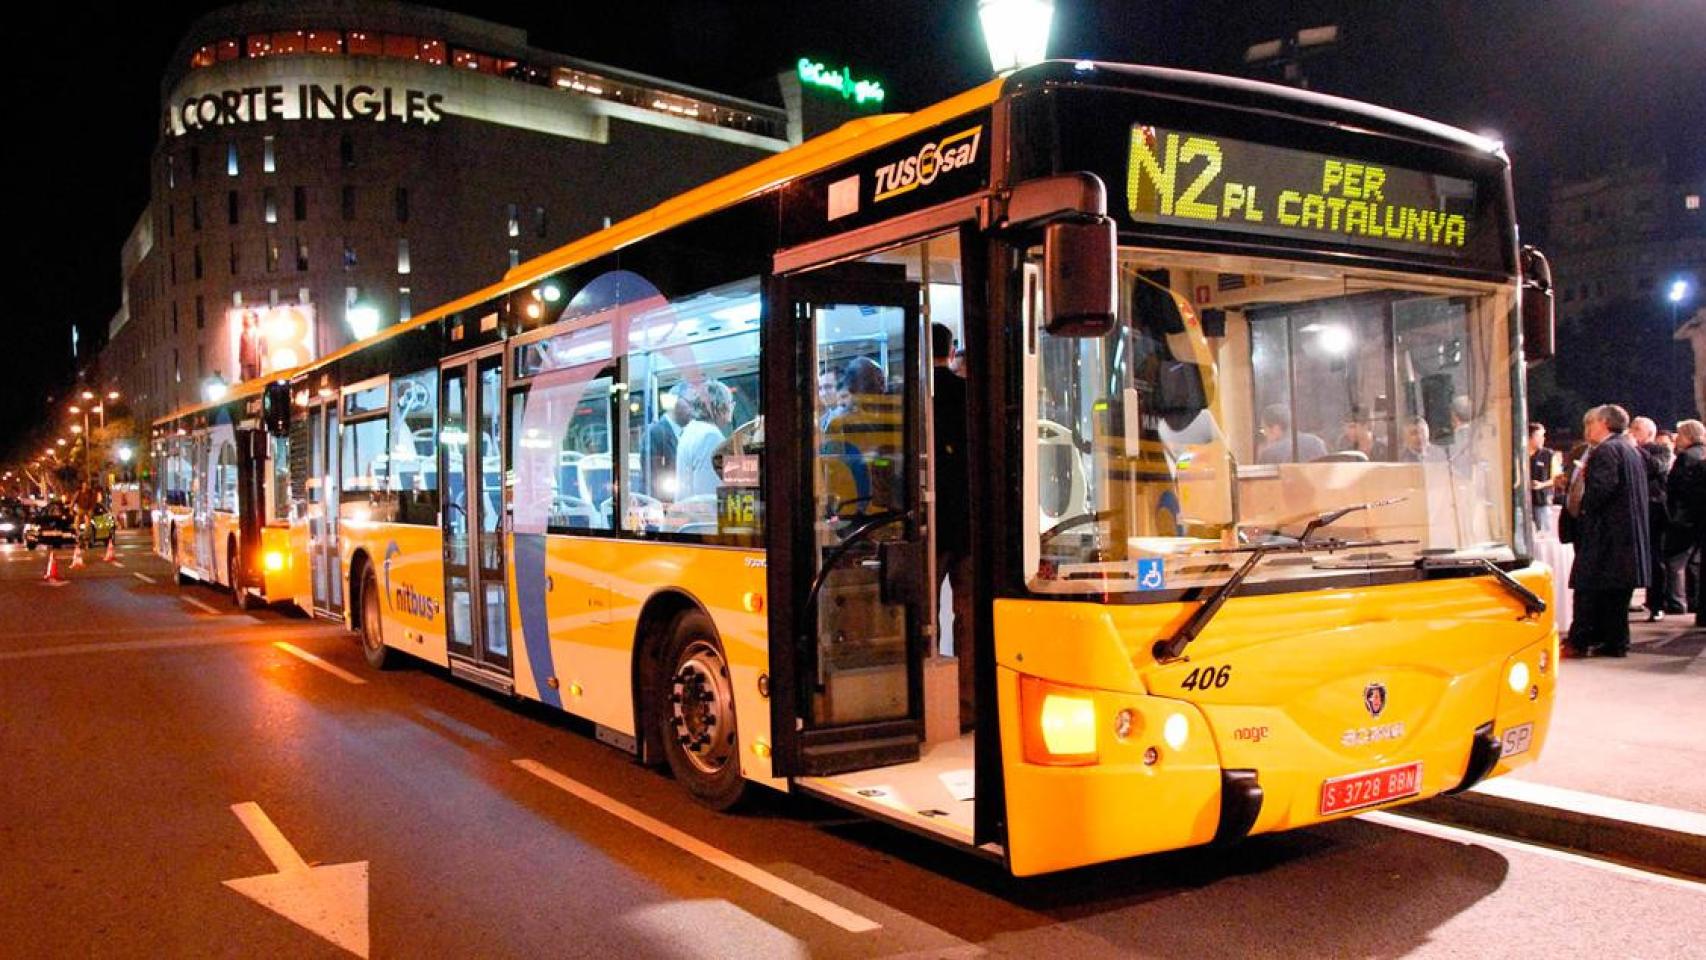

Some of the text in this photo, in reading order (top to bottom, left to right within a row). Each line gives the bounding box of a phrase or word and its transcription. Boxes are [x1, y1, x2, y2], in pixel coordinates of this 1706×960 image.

[181, 85, 283, 128] CORTE
[298, 84, 443, 125] INGLES
[1127, 125, 1223, 220] N2
[1323, 160, 1386, 201] PER
[1222, 183, 1466, 247] PL CATALUNYA
[727, 492, 754, 524] N2
[396, 582, 434, 620] nitbus
[1181, 664, 1231, 691] 406
[1505, 727, 1529, 753] SP
[1327, 768, 1415, 807] S 3728 BBN
